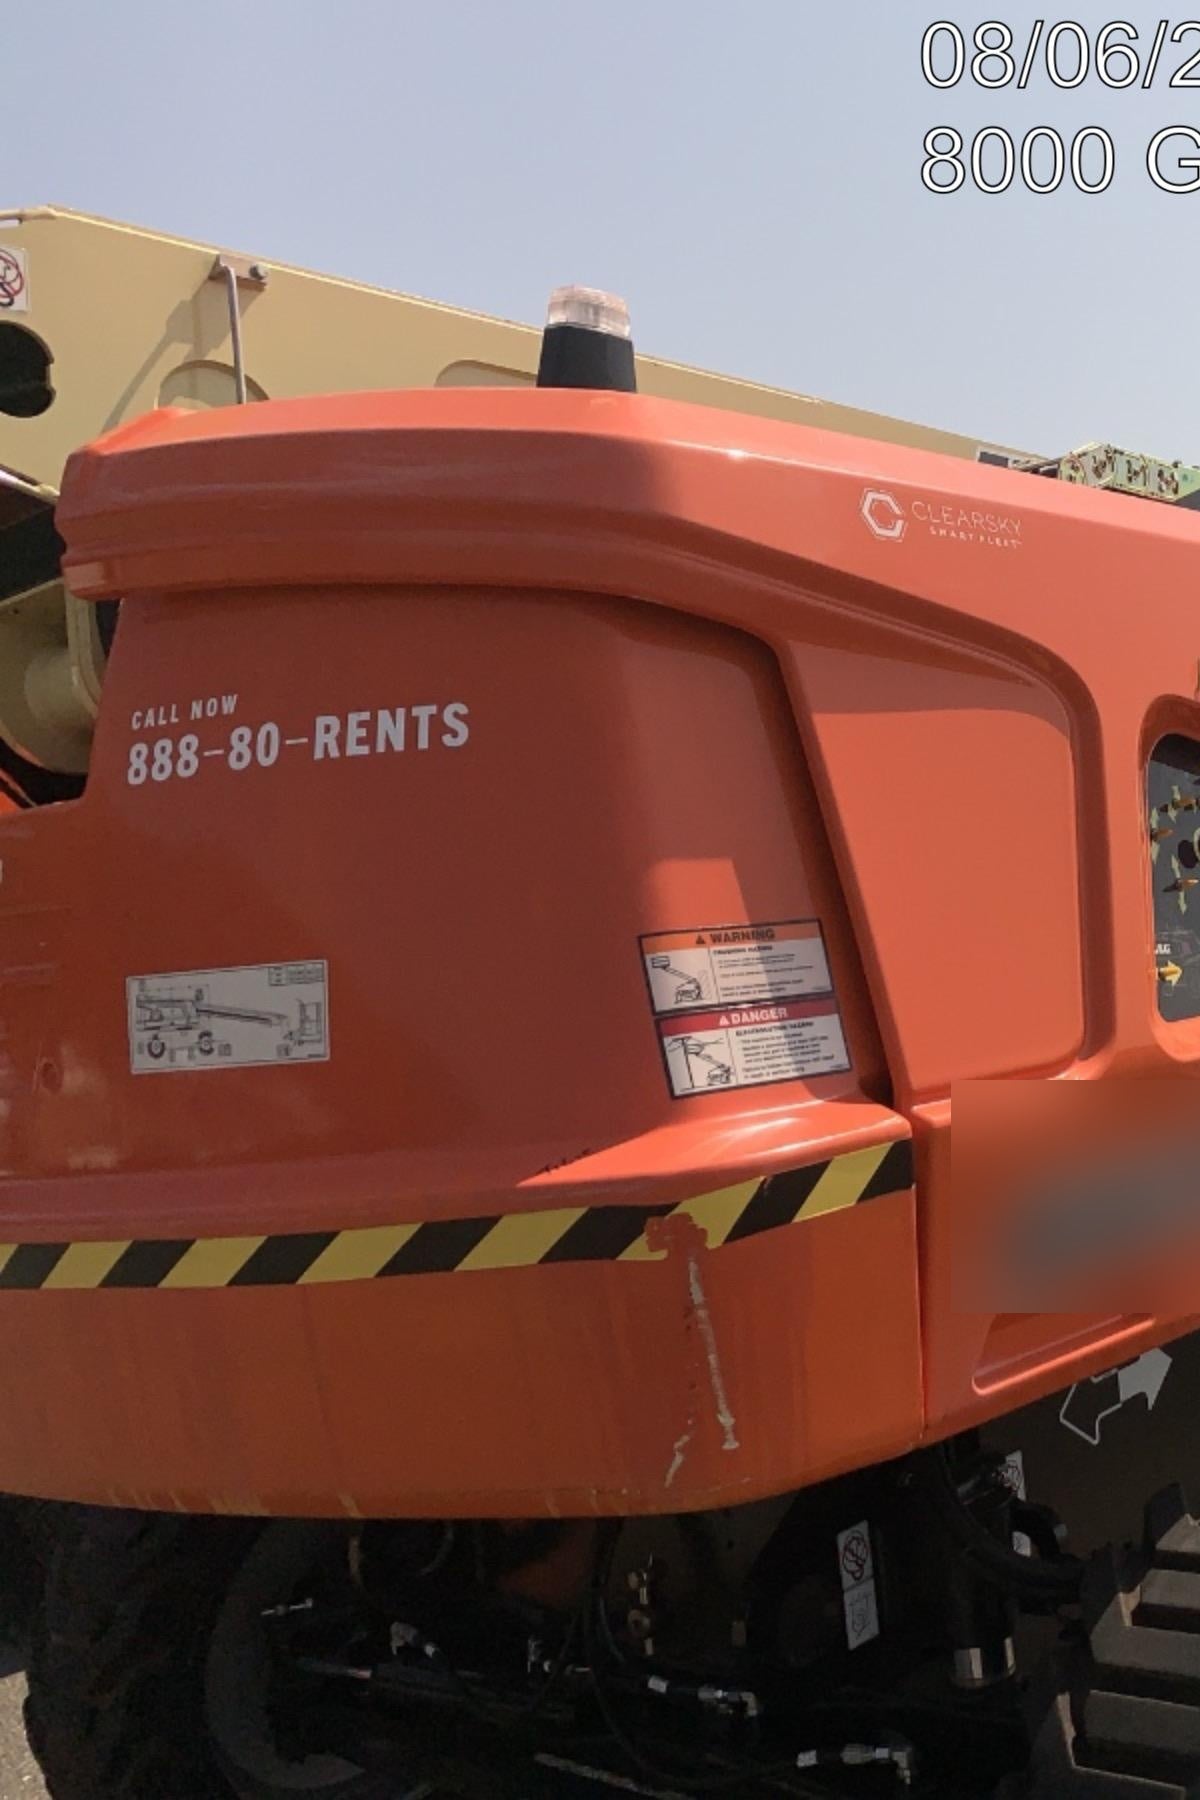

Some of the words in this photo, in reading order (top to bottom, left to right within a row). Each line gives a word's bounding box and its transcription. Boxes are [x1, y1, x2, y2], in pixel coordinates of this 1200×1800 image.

[911, 501, 1021, 536] CLEARSKY
[131, 704, 179, 730] CALL
[190, 694, 238, 720] NOW
[127, 702, 470, 785] 888-80-RENTS
[709, 927, 776, 944] WARNING
[730, 1007, 788, 1025] DANGER
